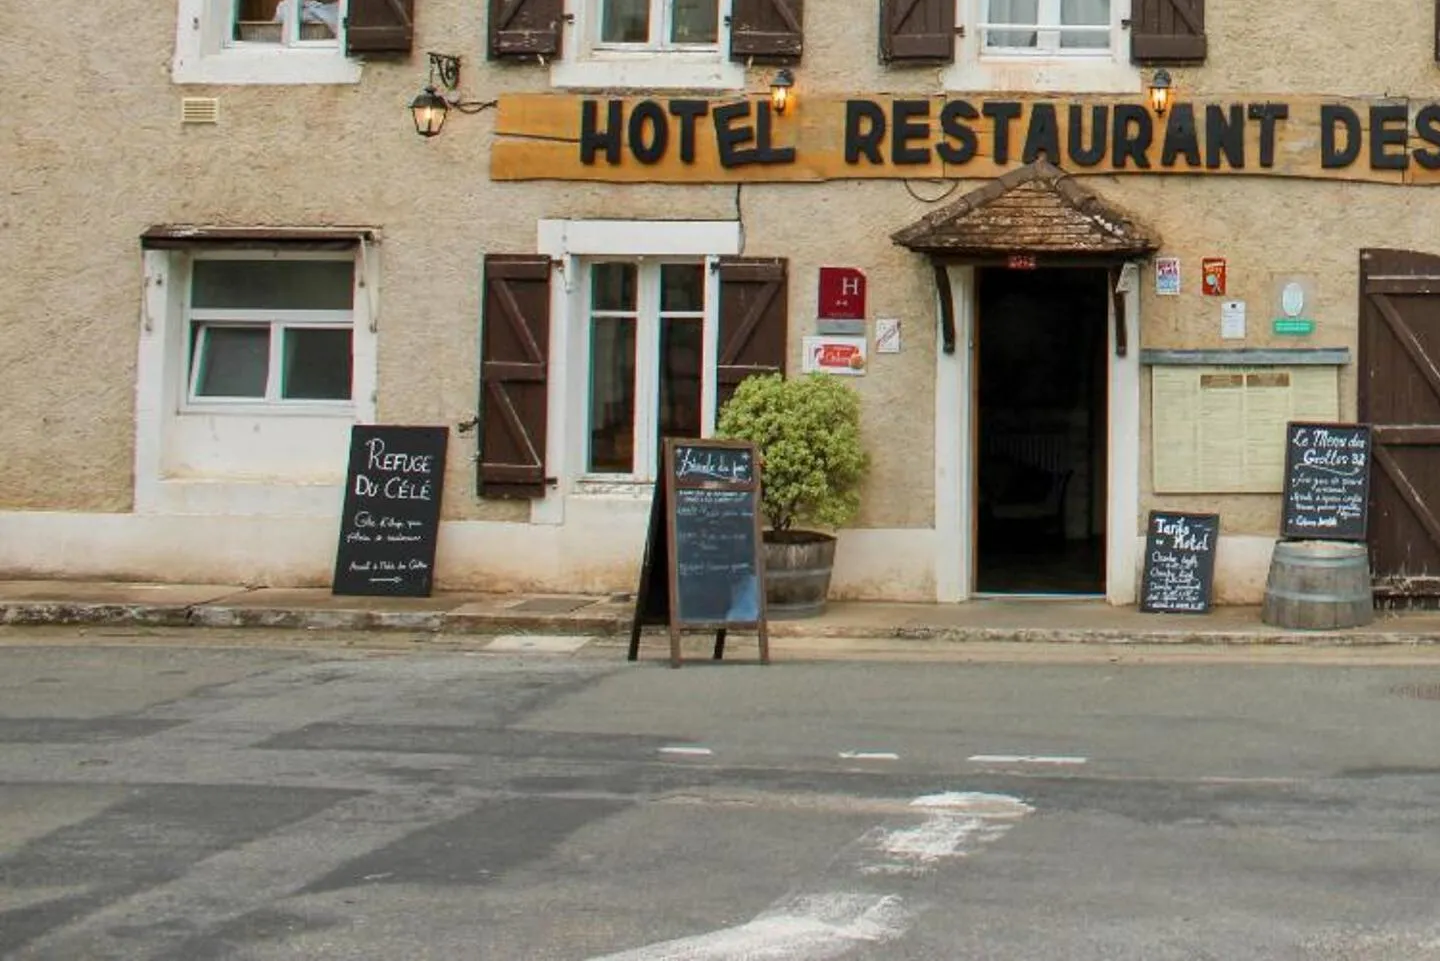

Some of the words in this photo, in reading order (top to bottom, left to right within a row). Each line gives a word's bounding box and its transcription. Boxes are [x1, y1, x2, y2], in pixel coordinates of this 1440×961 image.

[580, 98, 797, 170] HOTEL
[844, 99, 1289, 169] RESTAURANT
[842, 276, 859, 296] H
